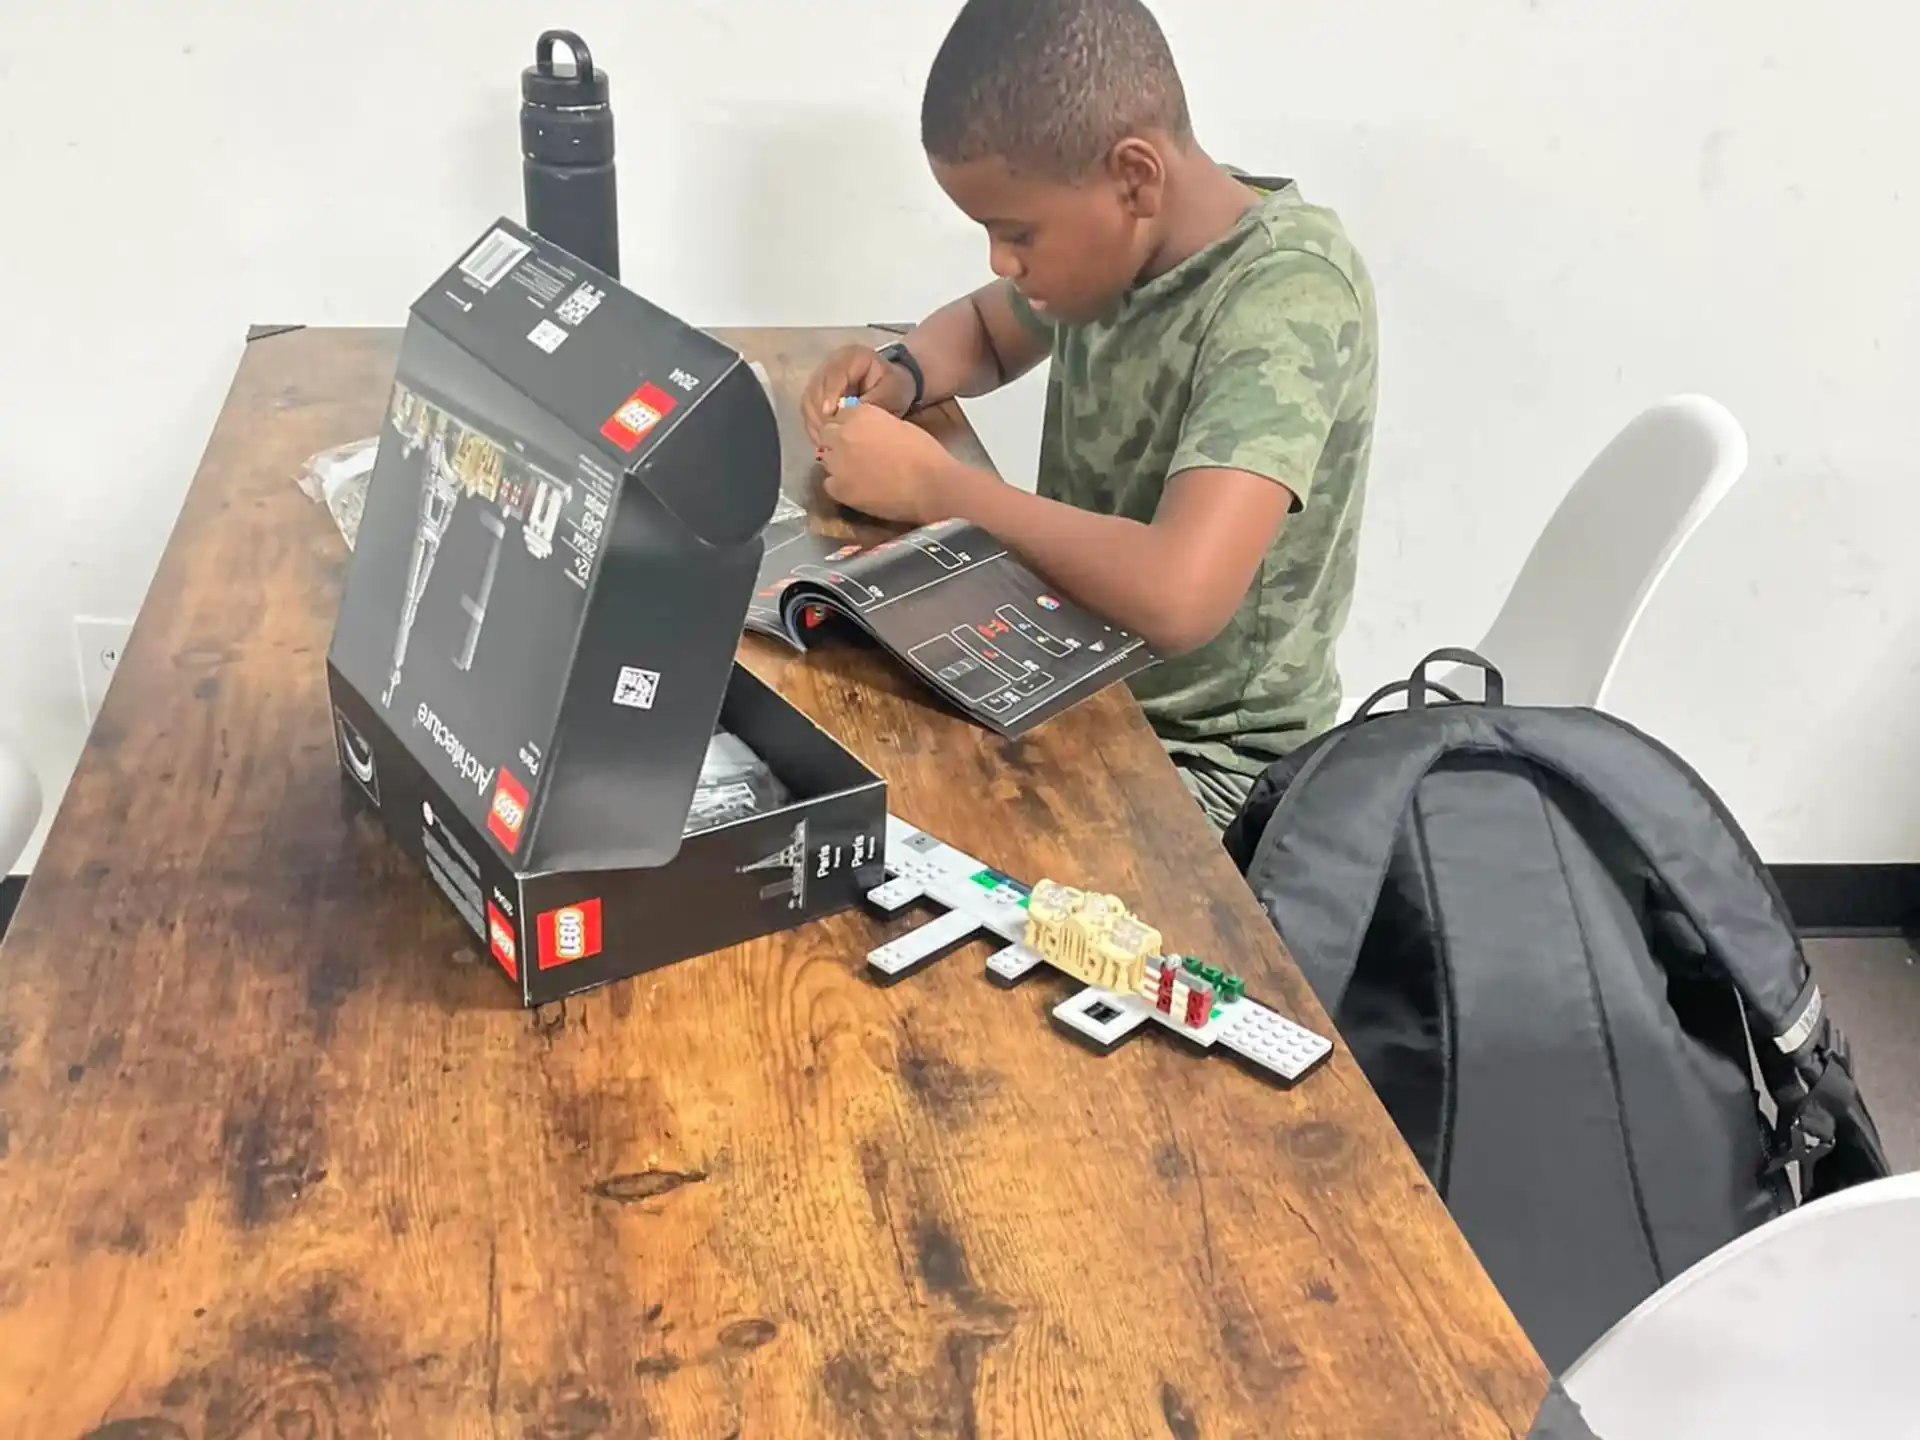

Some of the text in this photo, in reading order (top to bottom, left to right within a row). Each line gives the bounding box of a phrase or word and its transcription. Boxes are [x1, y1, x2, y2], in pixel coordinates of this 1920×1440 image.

[418, 702, 495, 796] Architecture
[817, 844, 830, 878] Paris
[851, 834, 865, 868] Paris
[557, 908, 584, 957] LEGO
